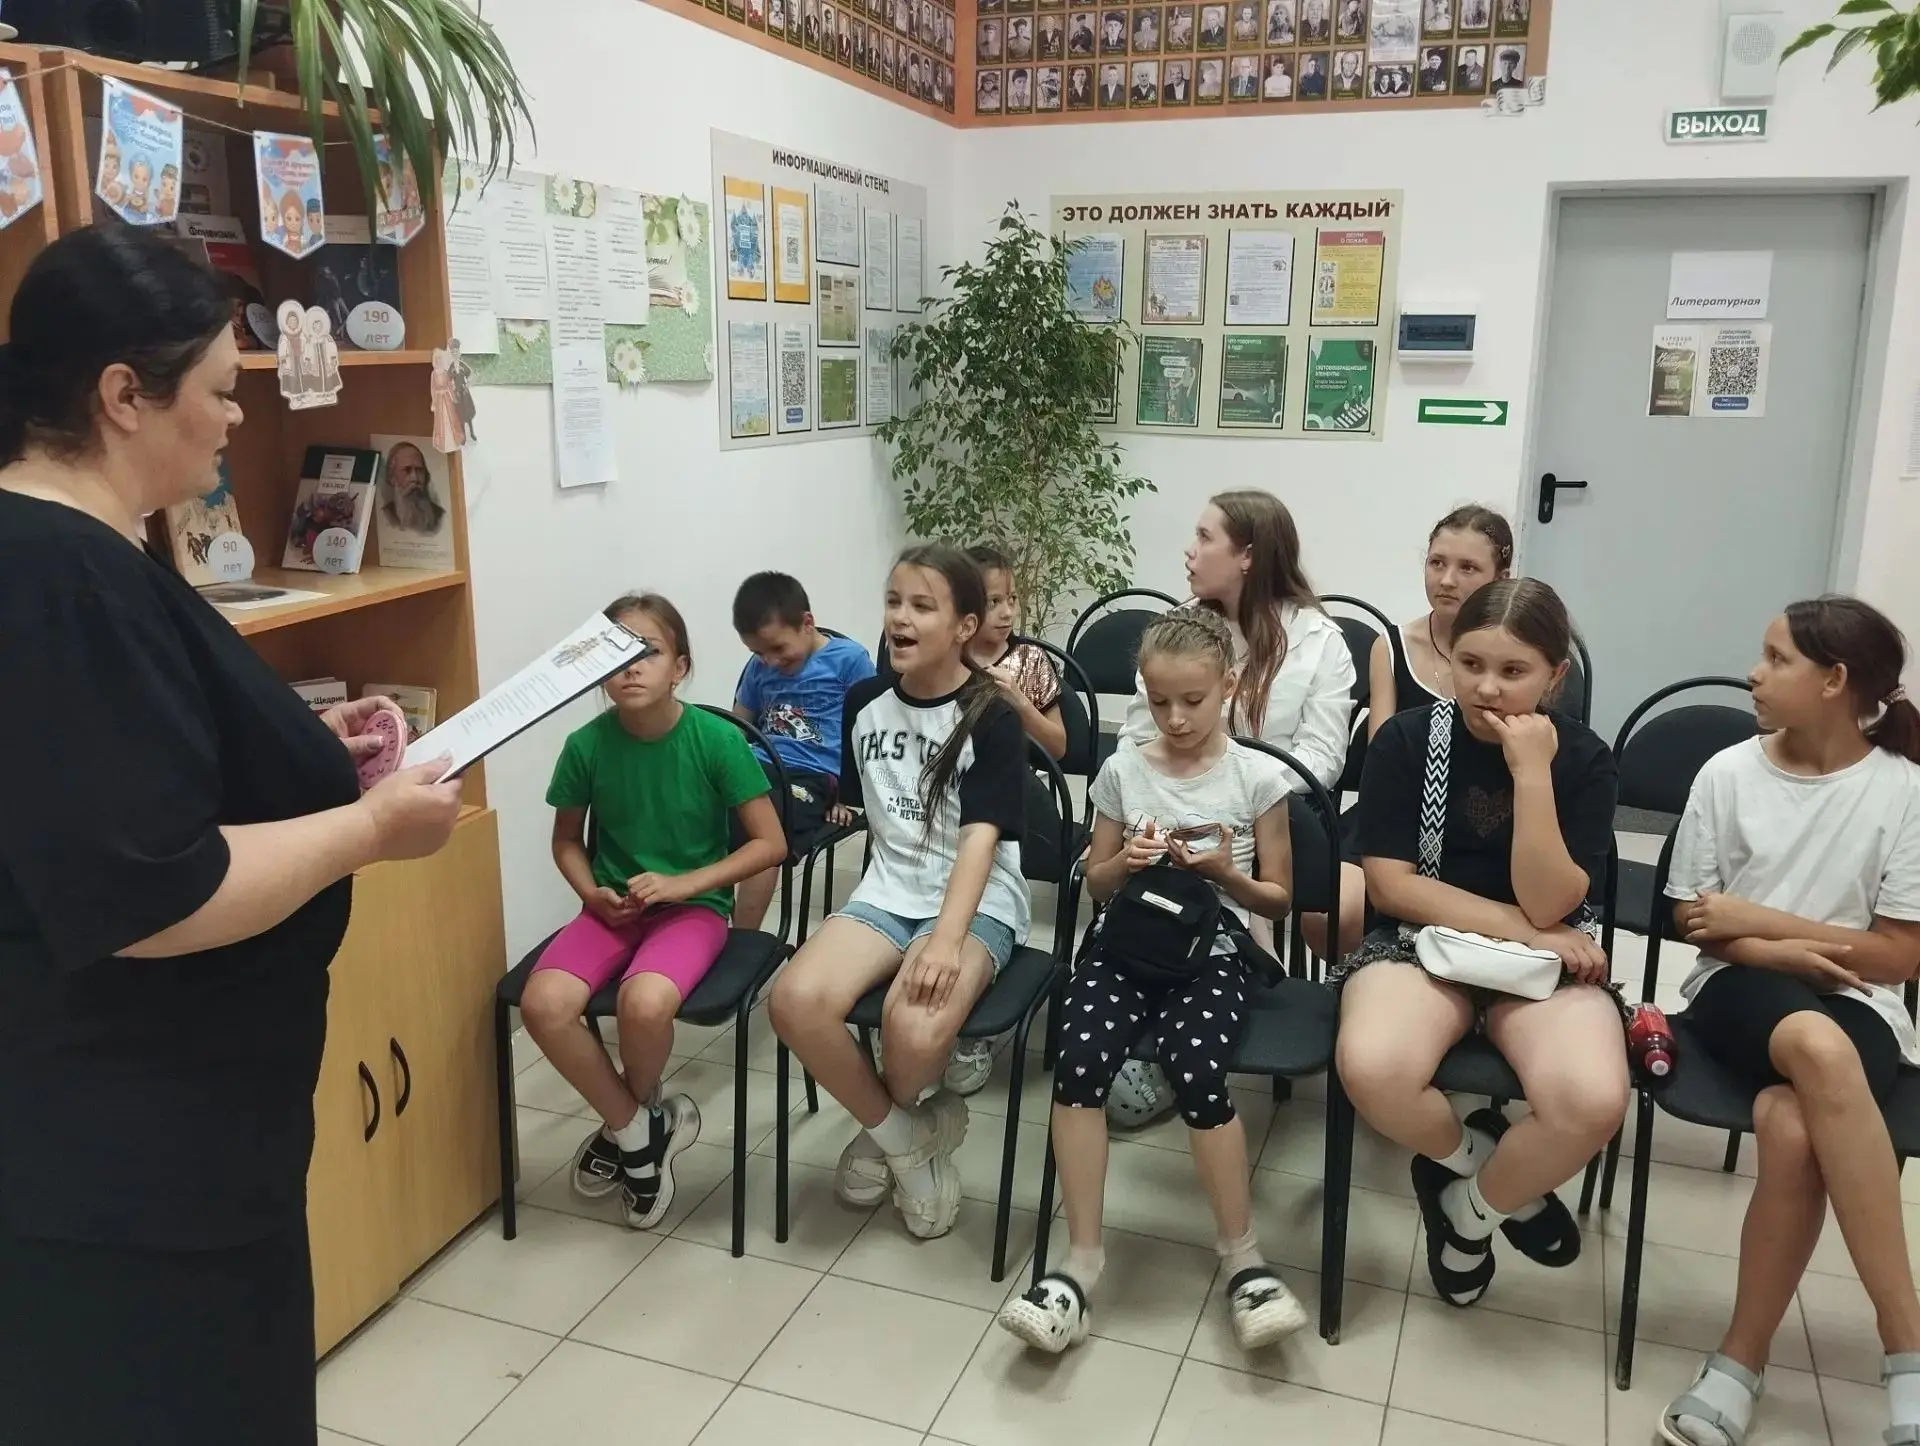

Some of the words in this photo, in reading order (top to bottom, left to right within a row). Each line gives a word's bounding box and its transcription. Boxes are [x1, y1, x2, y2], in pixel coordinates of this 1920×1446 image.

[1676, 113, 1760, 134] ВЫХОД
[772, 149, 863, 184] ИНФОРМАЦИОННЫЙ
[864, 174, 890, 194] СТЕНД
[1062, 206, 1103, 222] ЭТО
[1108, 204, 1200, 224] ДОЛЖЕН
[1208, 203, 1278, 219] ЗНАТЬ
[1285, 198, 1390, 220] КАЖДЫЙ
[1670, 297, 1761, 308] Литературная
[363, 310, 390, 324] 190
[365, 334, 391, 344] лет
[222, 540, 238, 553] 90
[326, 535, 348, 548] 140
[222, 562, 243, 574] лет
[324, 556, 345, 568] лет
[900, 808, 927, 821] NEVER
